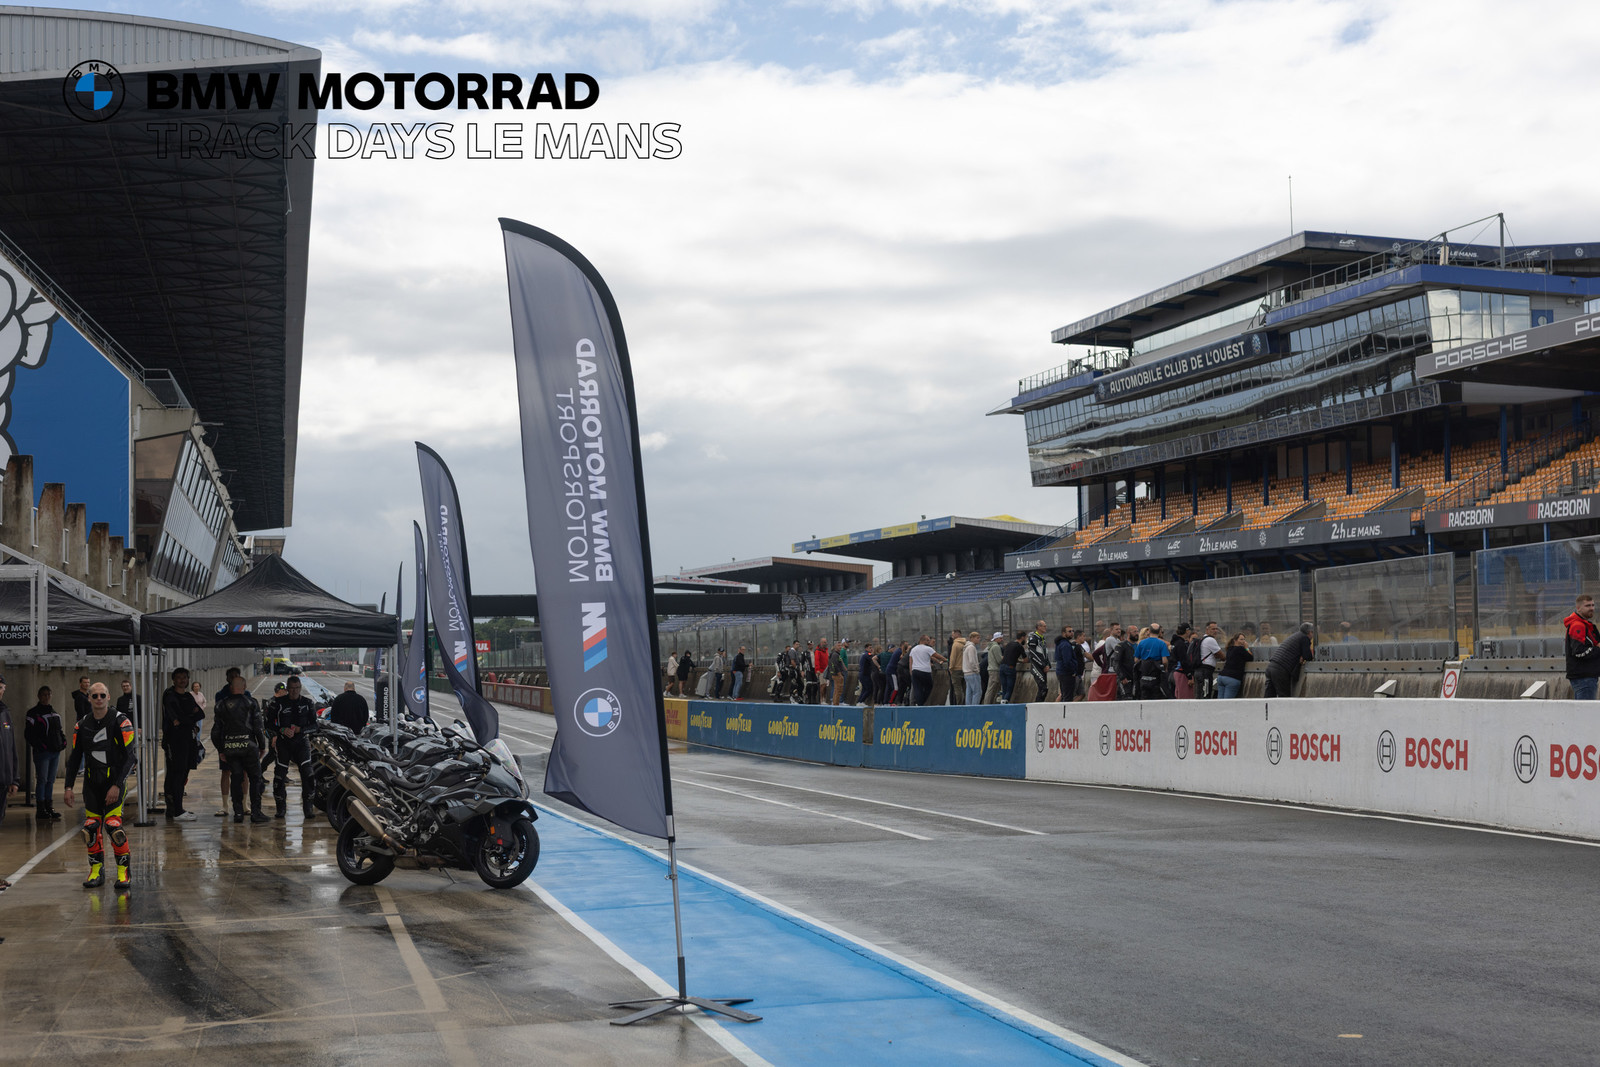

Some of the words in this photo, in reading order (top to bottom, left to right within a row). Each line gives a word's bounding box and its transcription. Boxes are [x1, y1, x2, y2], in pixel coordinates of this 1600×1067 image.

[1435, 334, 1528, 370] PORSCHE
[1110, 366, 1163, 394] AUTOMOBILE
[1164, 359, 1189, 378] CLUB
[1190, 354, 1204, 370] DE
[1205, 341, 1246, 366] L'OUEST
[1448, 508, 1494, 528] RACEBORN
[1537, 498, 1591, 520] RACEBORN
[1346, 528, 1356, 538] LE
[1357, 524, 1381, 537] MANS
[1107, 553, 1114, 561] LE
[1114, 551, 1128, 560] MANS
[1211, 542, 1219, 551] LE
[1219, 539, 1238, 550] MANS
[1029, 560, 1040, 568] MANS
[690, 712, 712, 730] GOODYEAR
[726, 715, 752, 734] GOODYEAR
[768, 718, 799, 738] GOODYEAR
[818, 721, 856, 744] GOODYEAR
[880, 724, 926, 749] GOODYEAR
[956, 725, 1013, 752] GOODYEAR
[1049, 728, 1079, 750] BOSCH
[1115, 729, 1151, 752] BOSCH
[1194, 730, 1238, 756] BOSCH
[1290, 733, 1341, 762] BOSCH
[1405, 737, 1468, 771] BOSCH
[1550, 743, 1600, 781] BOS
